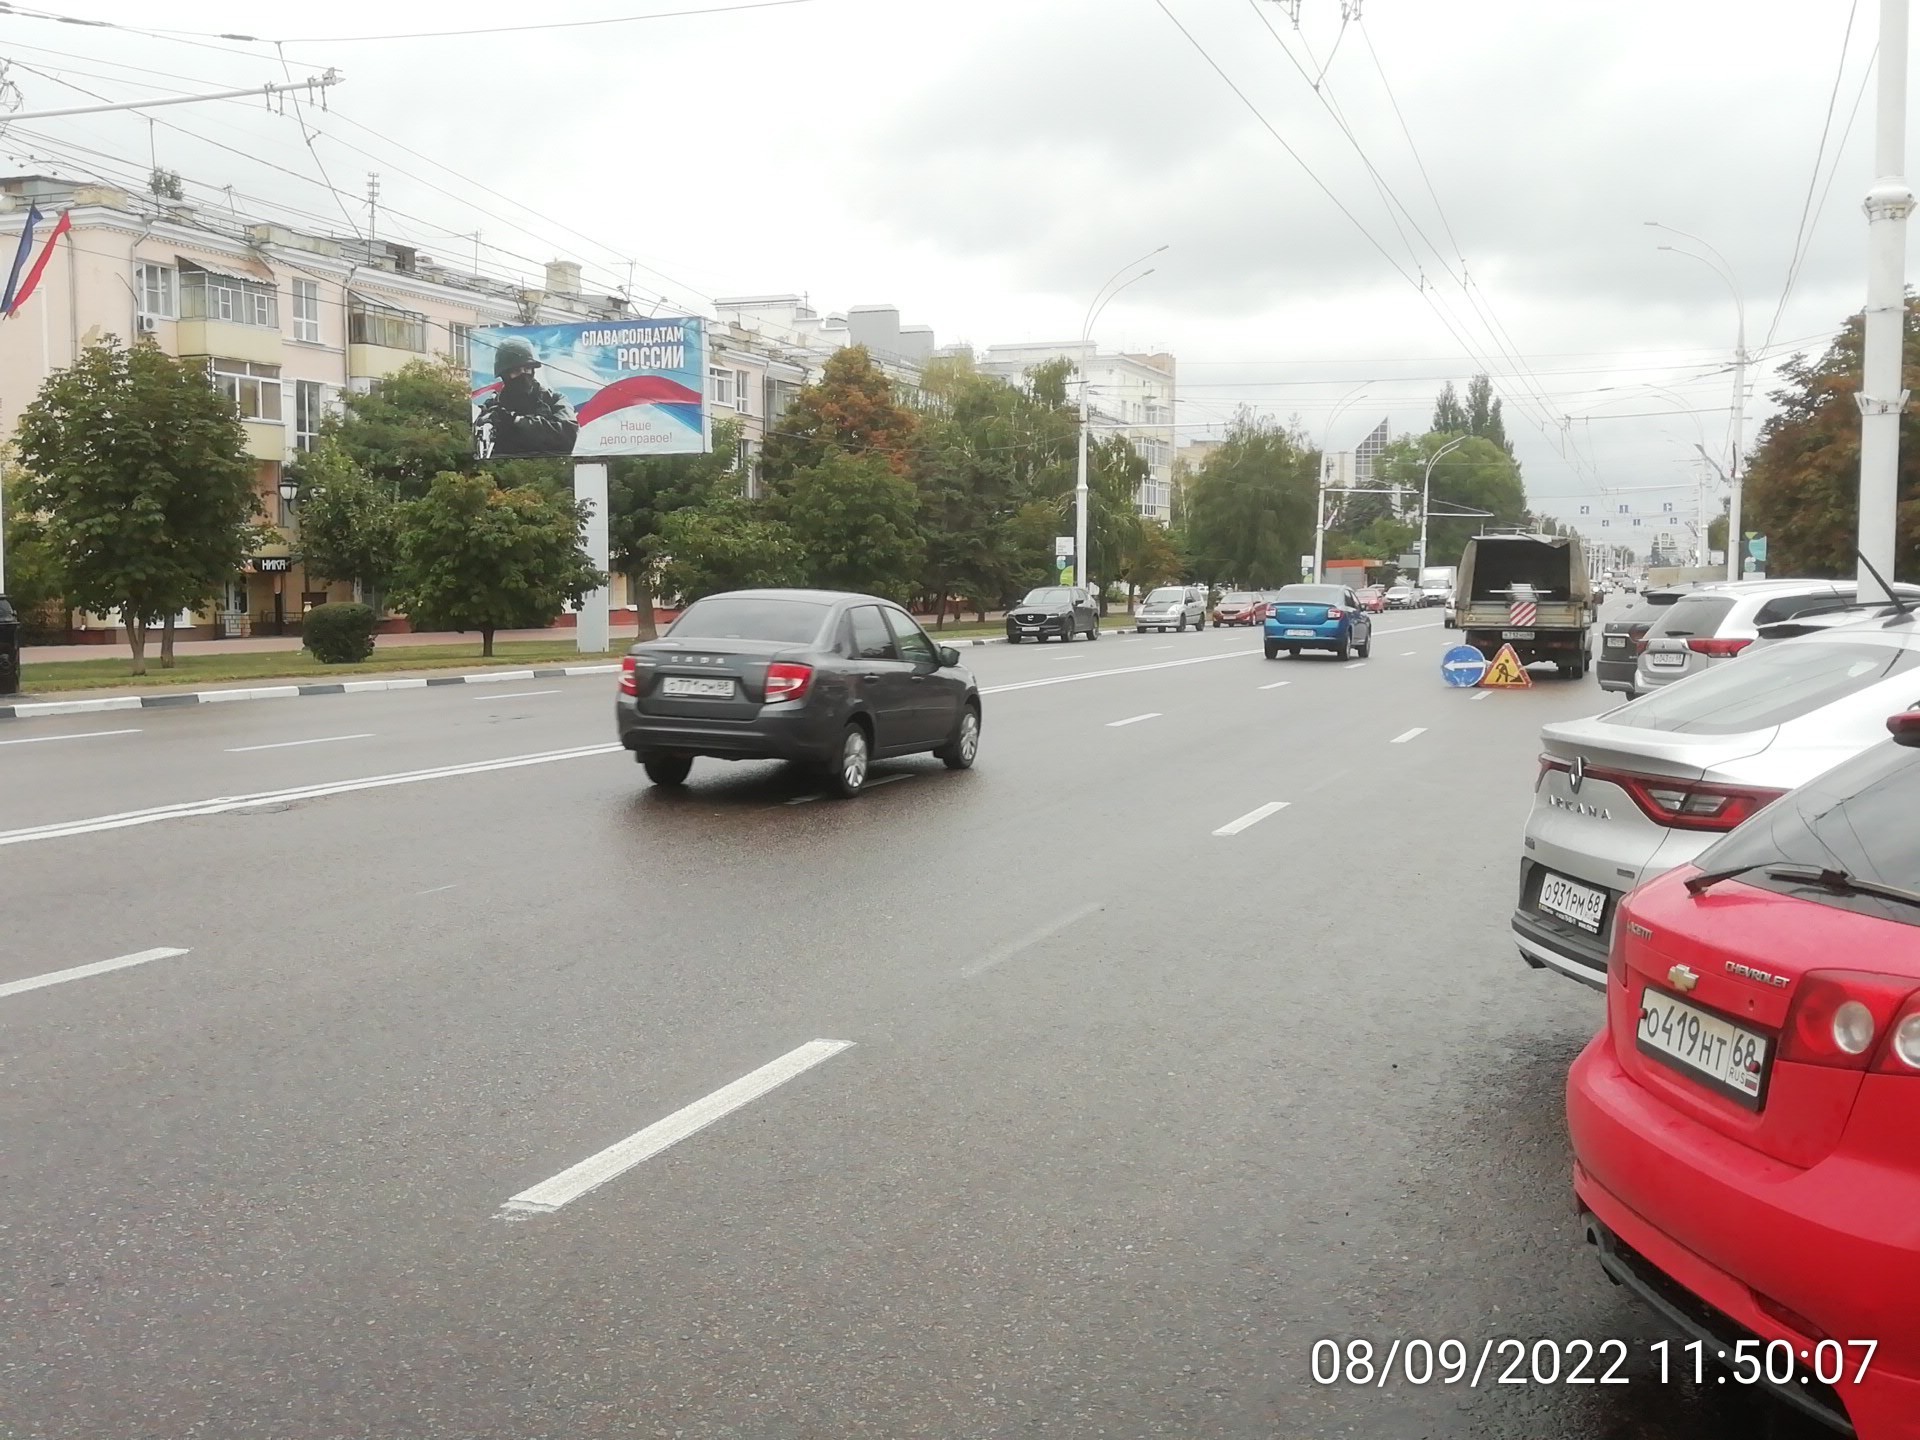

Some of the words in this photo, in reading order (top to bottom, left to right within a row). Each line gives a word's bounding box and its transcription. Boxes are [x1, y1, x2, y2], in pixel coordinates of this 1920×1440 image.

[581, 329, 618, 346] СЛАВА
[622, 326, 684, 346] СОЛДАТАМ
[617, 345, 684, 371] РОССИИ
[620, 420, 651, 431] Наше
[600, 435, 627, 446] дело
[630, 432, 673, 446] правое!
[1548, 794, 1612, 820] ARKANA
[1587, 893, 1601, 914] 68
[1724, 960, 1791, 989] CHEVROLET
[1732, 1033, 1758, 1074] 68
[1728, 1066, 1746, 1085] RUS
